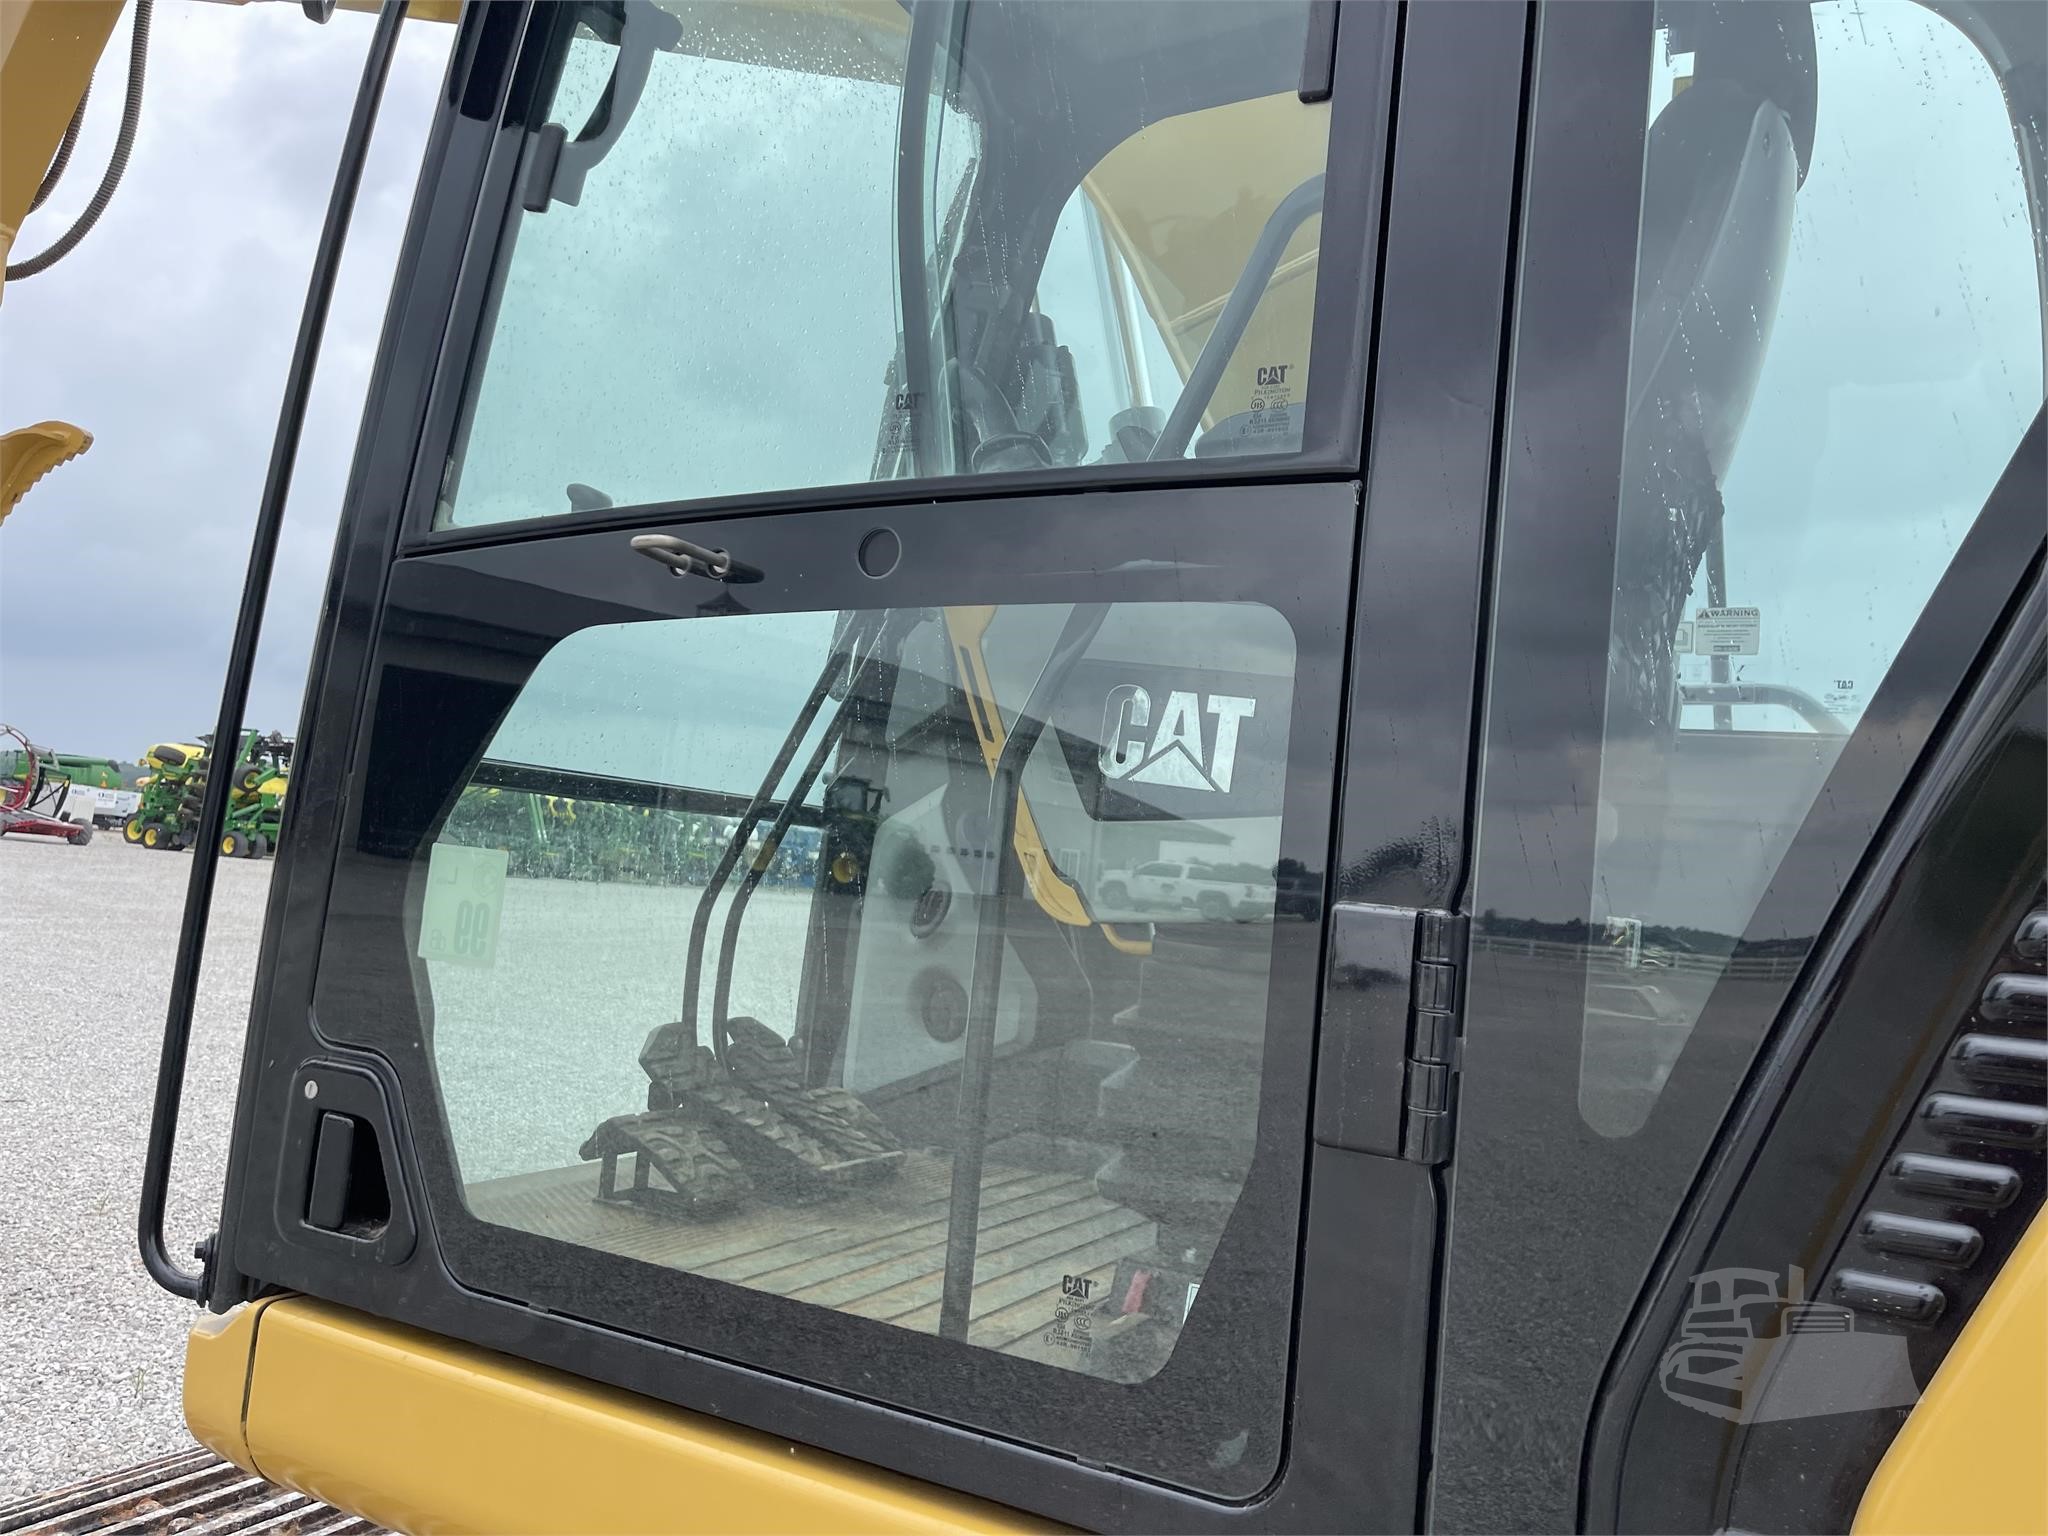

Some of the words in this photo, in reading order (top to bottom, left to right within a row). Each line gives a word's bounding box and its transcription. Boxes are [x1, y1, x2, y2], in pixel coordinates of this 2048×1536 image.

[1257, 365, 1288, 386] CAT
[895, 393, 924, 410] CAT
[1709, 609, 1759, 618] WARNING
[1099, 684, 1256, 793] CAT
[1062, 1274, 1092, 1300] CAT
